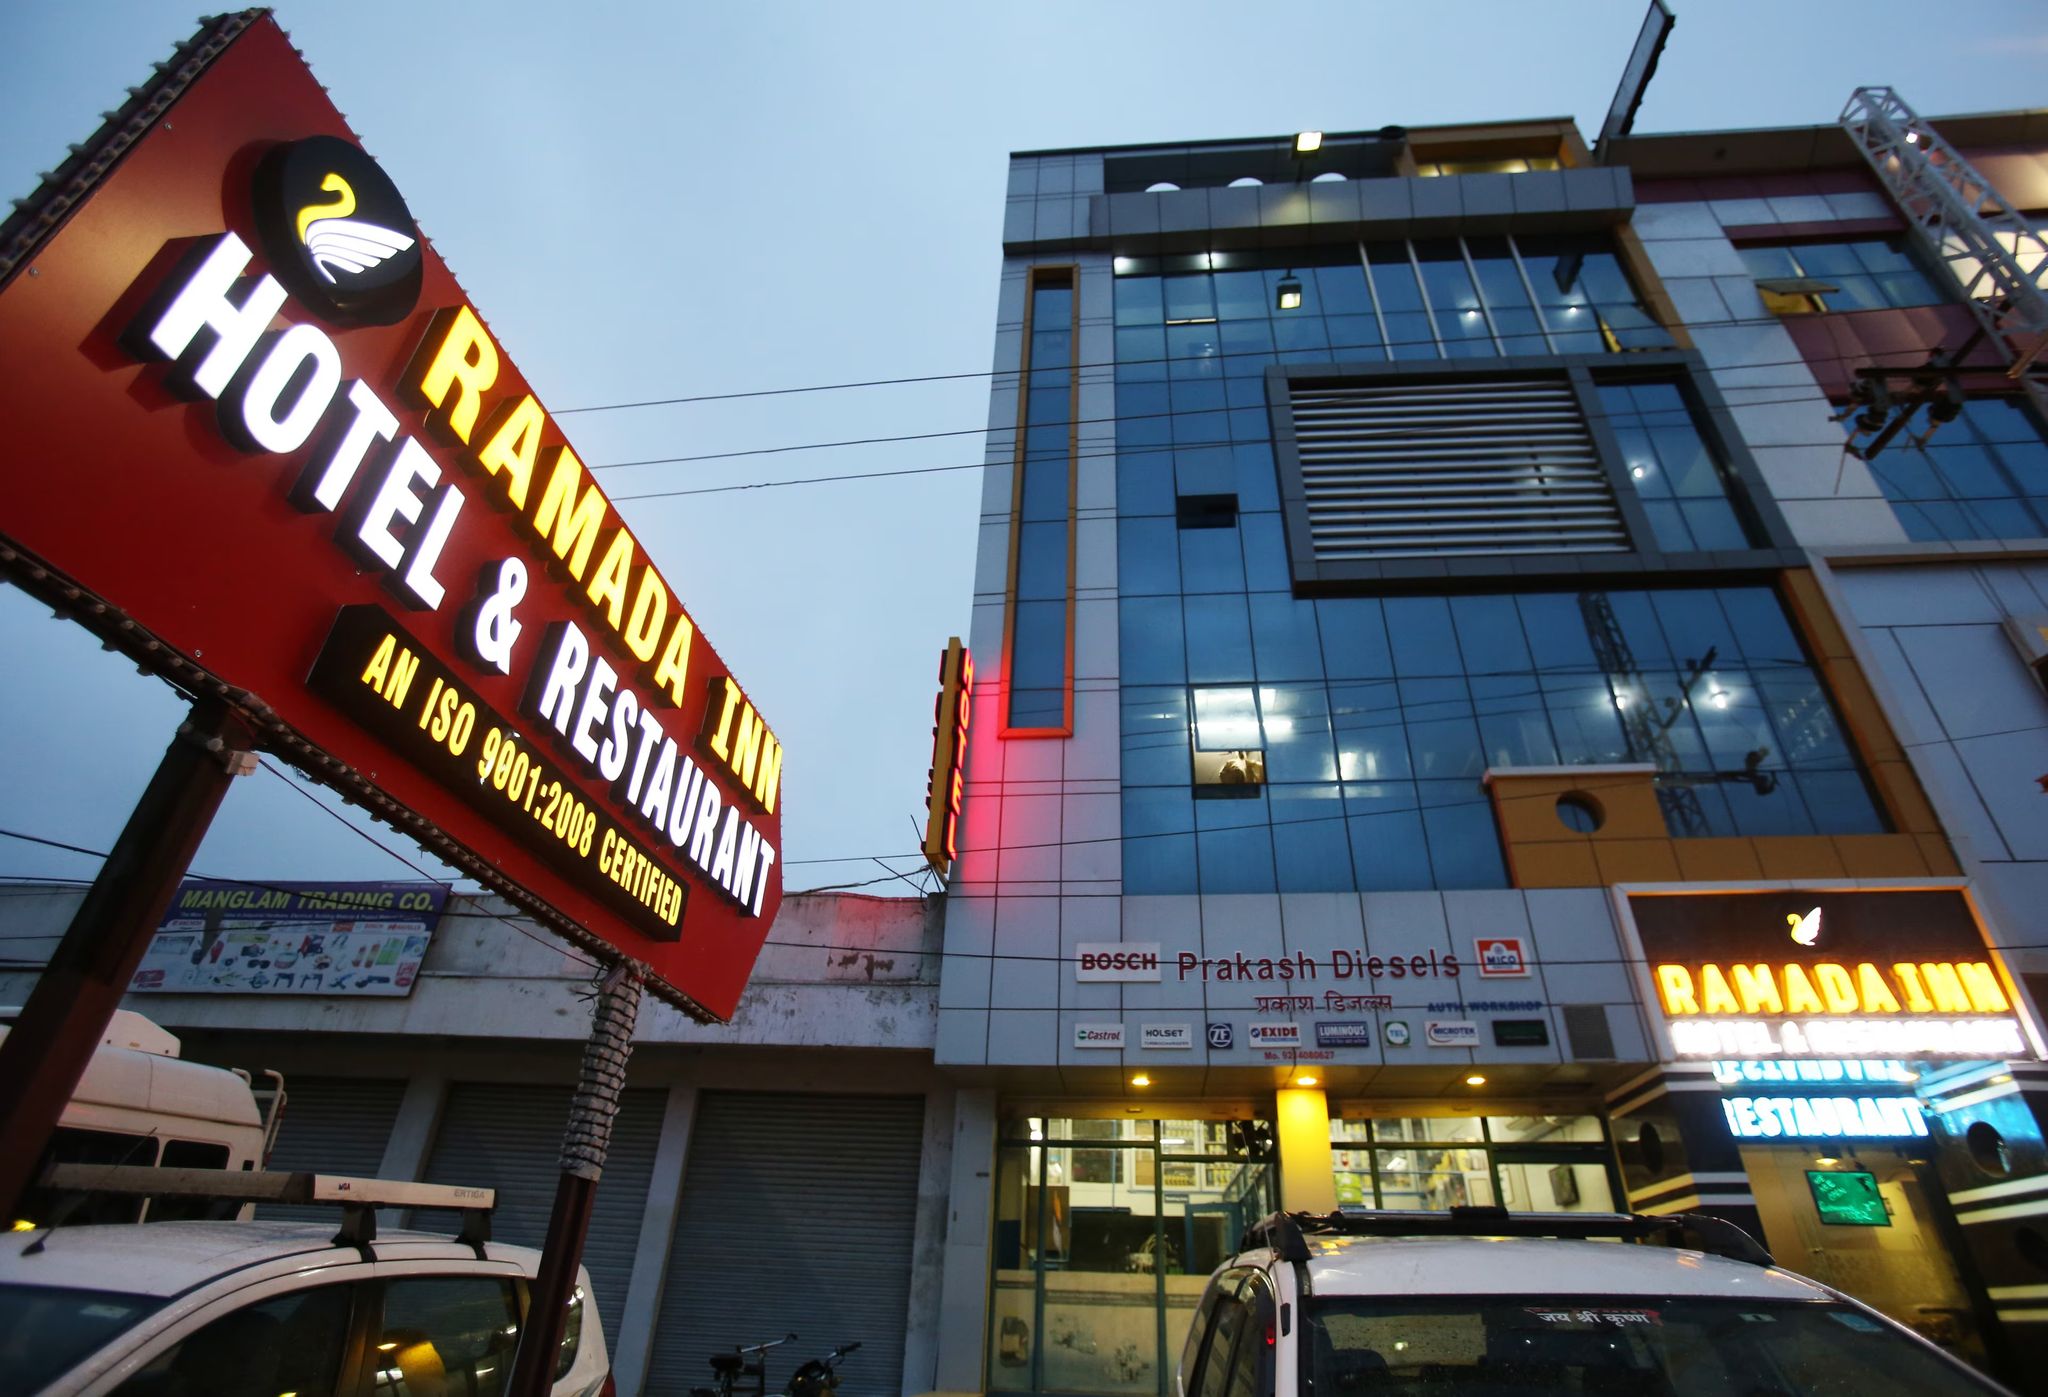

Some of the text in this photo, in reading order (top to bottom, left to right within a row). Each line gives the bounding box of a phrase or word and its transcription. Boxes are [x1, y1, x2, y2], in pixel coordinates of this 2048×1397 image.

[420, 304, 783, 815] RAMADA INN
[150, 231, 776, 918] HOTEL & RESTAURANT
[945, 648, 975, 861] HOTEL
[361, 633, 682, 927] AN ISO 9001:2008 CERTIFIED
[180, 890, 434, 911] MANGLAM TRADING CO.
[1081, 953, 1157, 970] BOSCH
[1178, 948, 1461, 981] Prakash Diesels
[1657, 963, 2010, 1014] RAMADA INN
[1254, 996, 1314, 1012] प्रकाश
[1468, 1001, 1543, 1012] WORKSHOP
[1087, 1030, 1121, 1041] Castrol
[1146, 1029, 1184, 1037] HOLSET
[1211, 1030, 1230, 1041] ZF
[1261, 1027, 1298, 1037] EXIDE
[1319, 1026, 1366, 1036] LUMINOUS
[454, 1188, 485, 1199] ERTIGA
[1537, 1310, 1650, 1327] जय श्री कृष्ण
